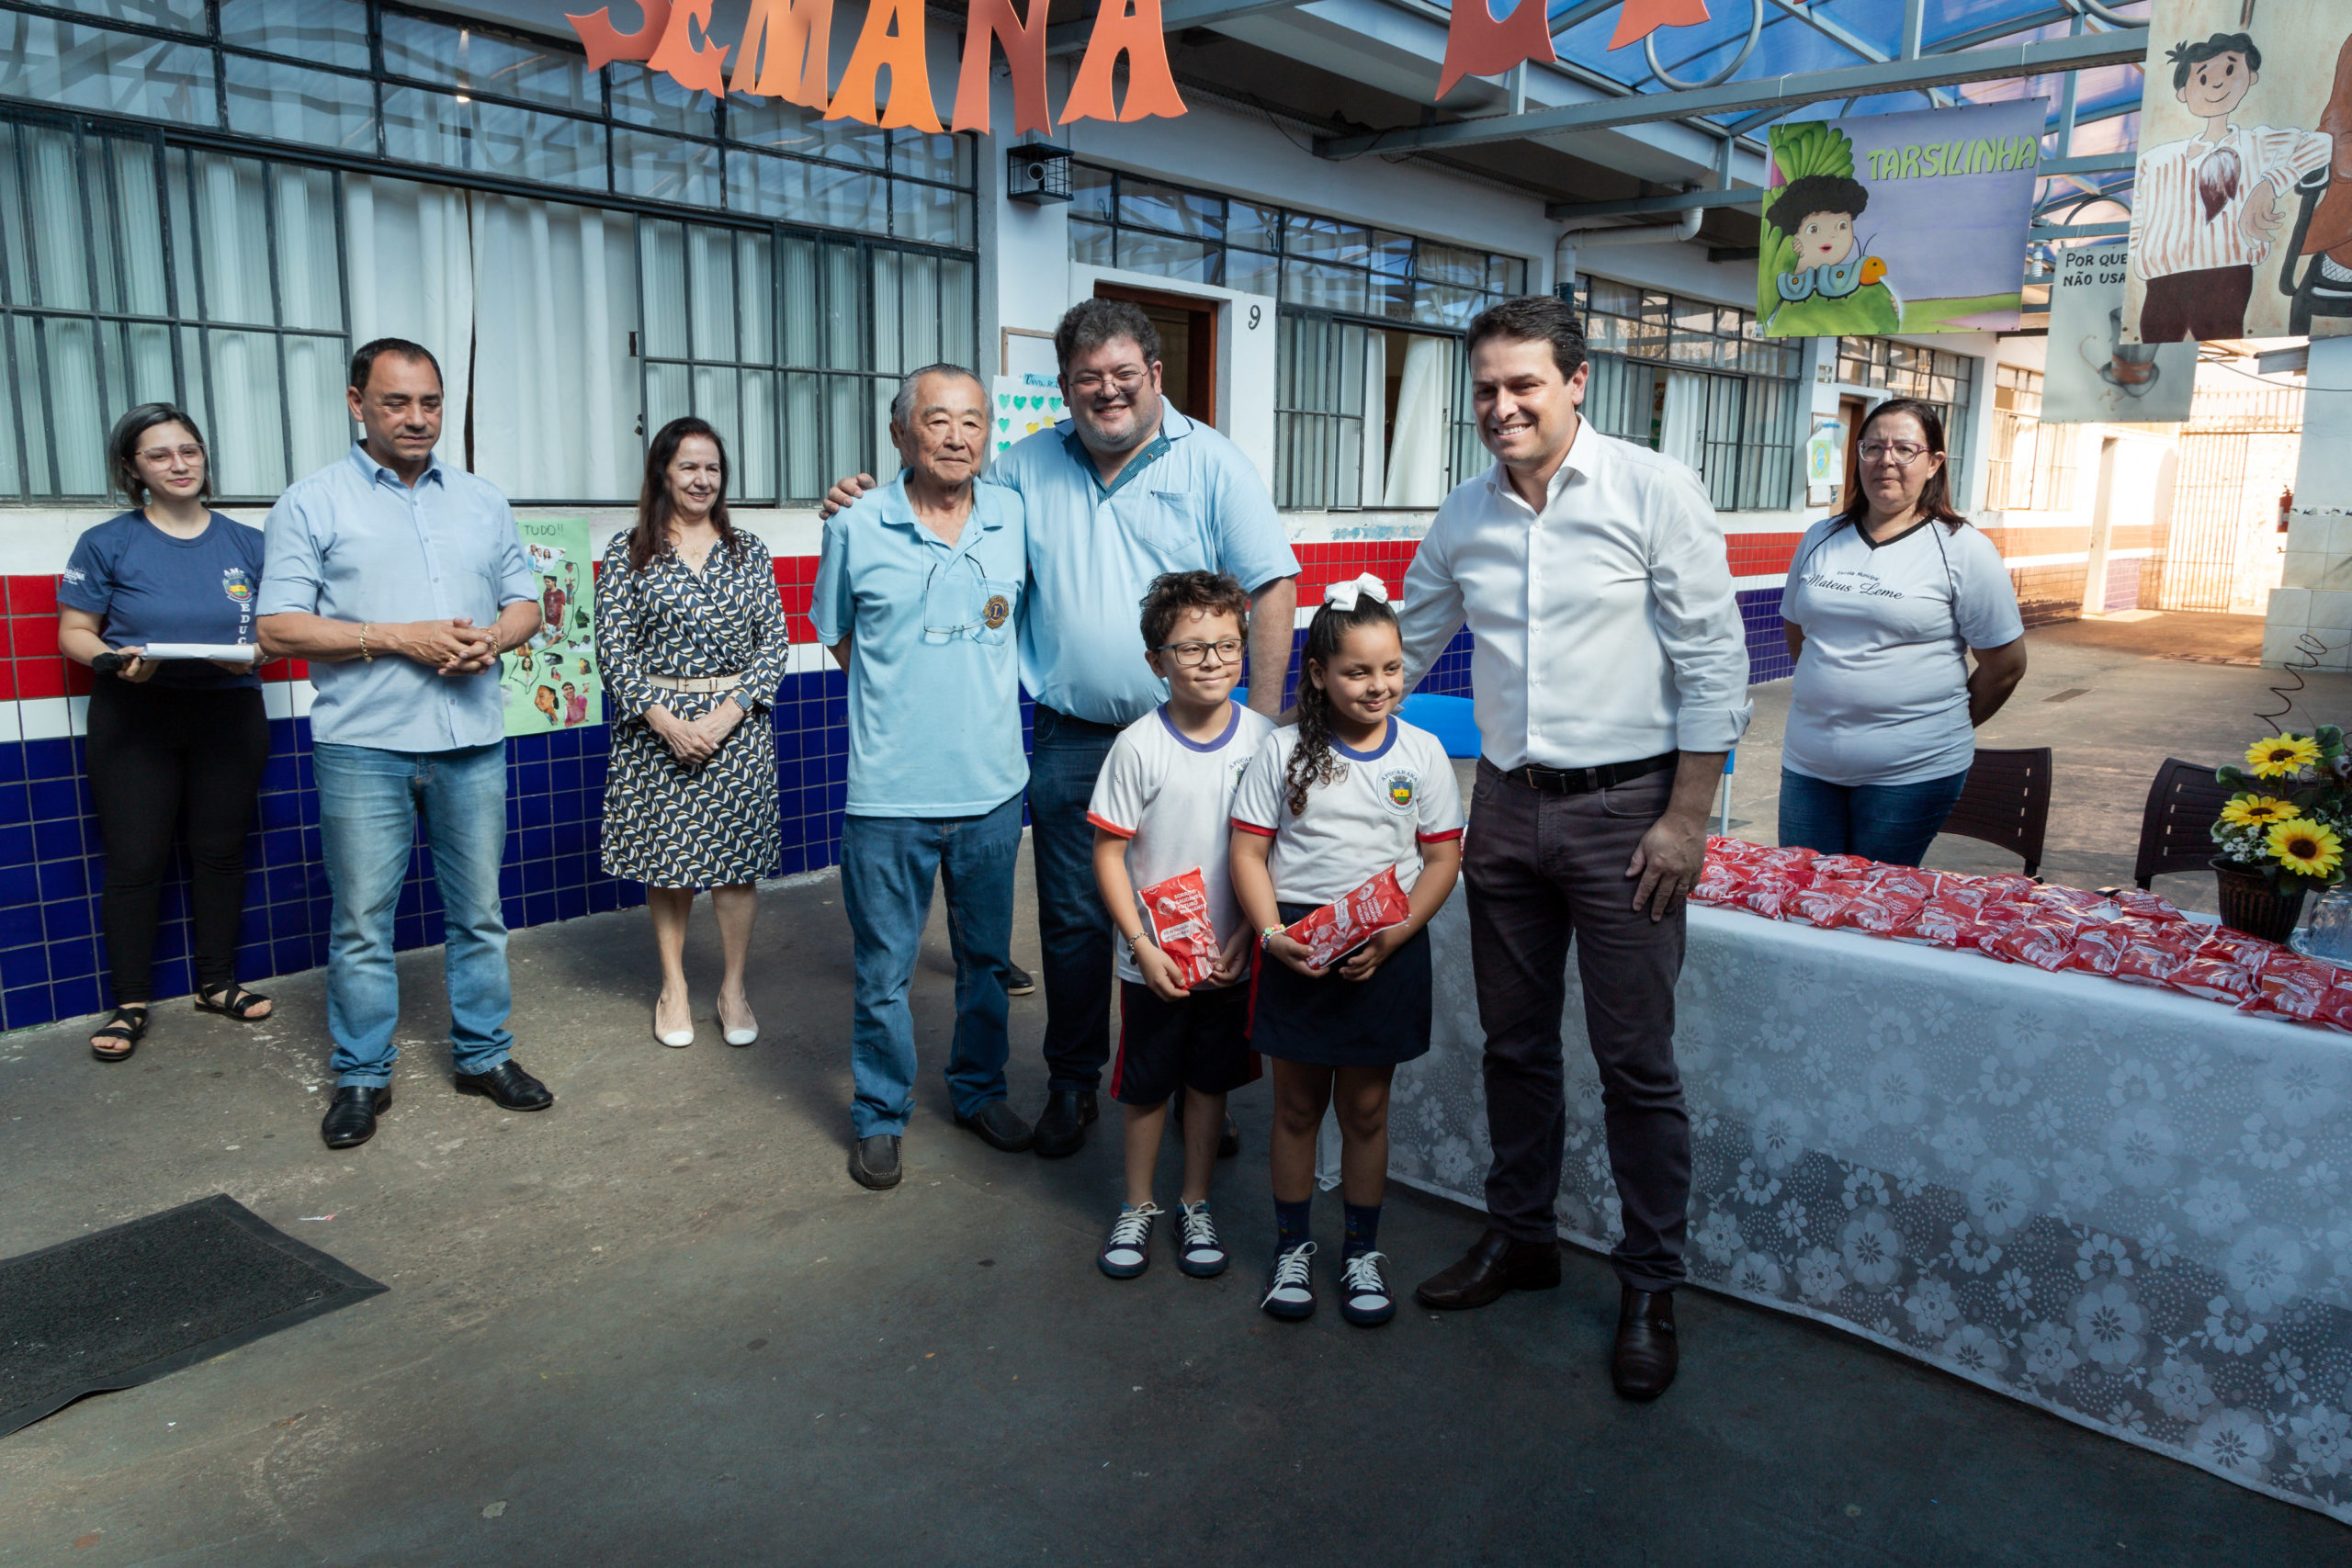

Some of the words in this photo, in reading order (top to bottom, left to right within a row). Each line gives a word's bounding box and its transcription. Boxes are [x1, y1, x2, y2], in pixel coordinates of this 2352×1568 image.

[1867, 135, 2037, 181] TARSILINHA
[2066, 253, 2094, 267] POR
[2099, 254, 2128, 266] QUE
[2063, 271, 2093, 287] NÃO
[1249, 304, 1261, 330] 9
[1806, 573, 1852, 592] Mateus
[1859, 582, 1905, 599] Leme
